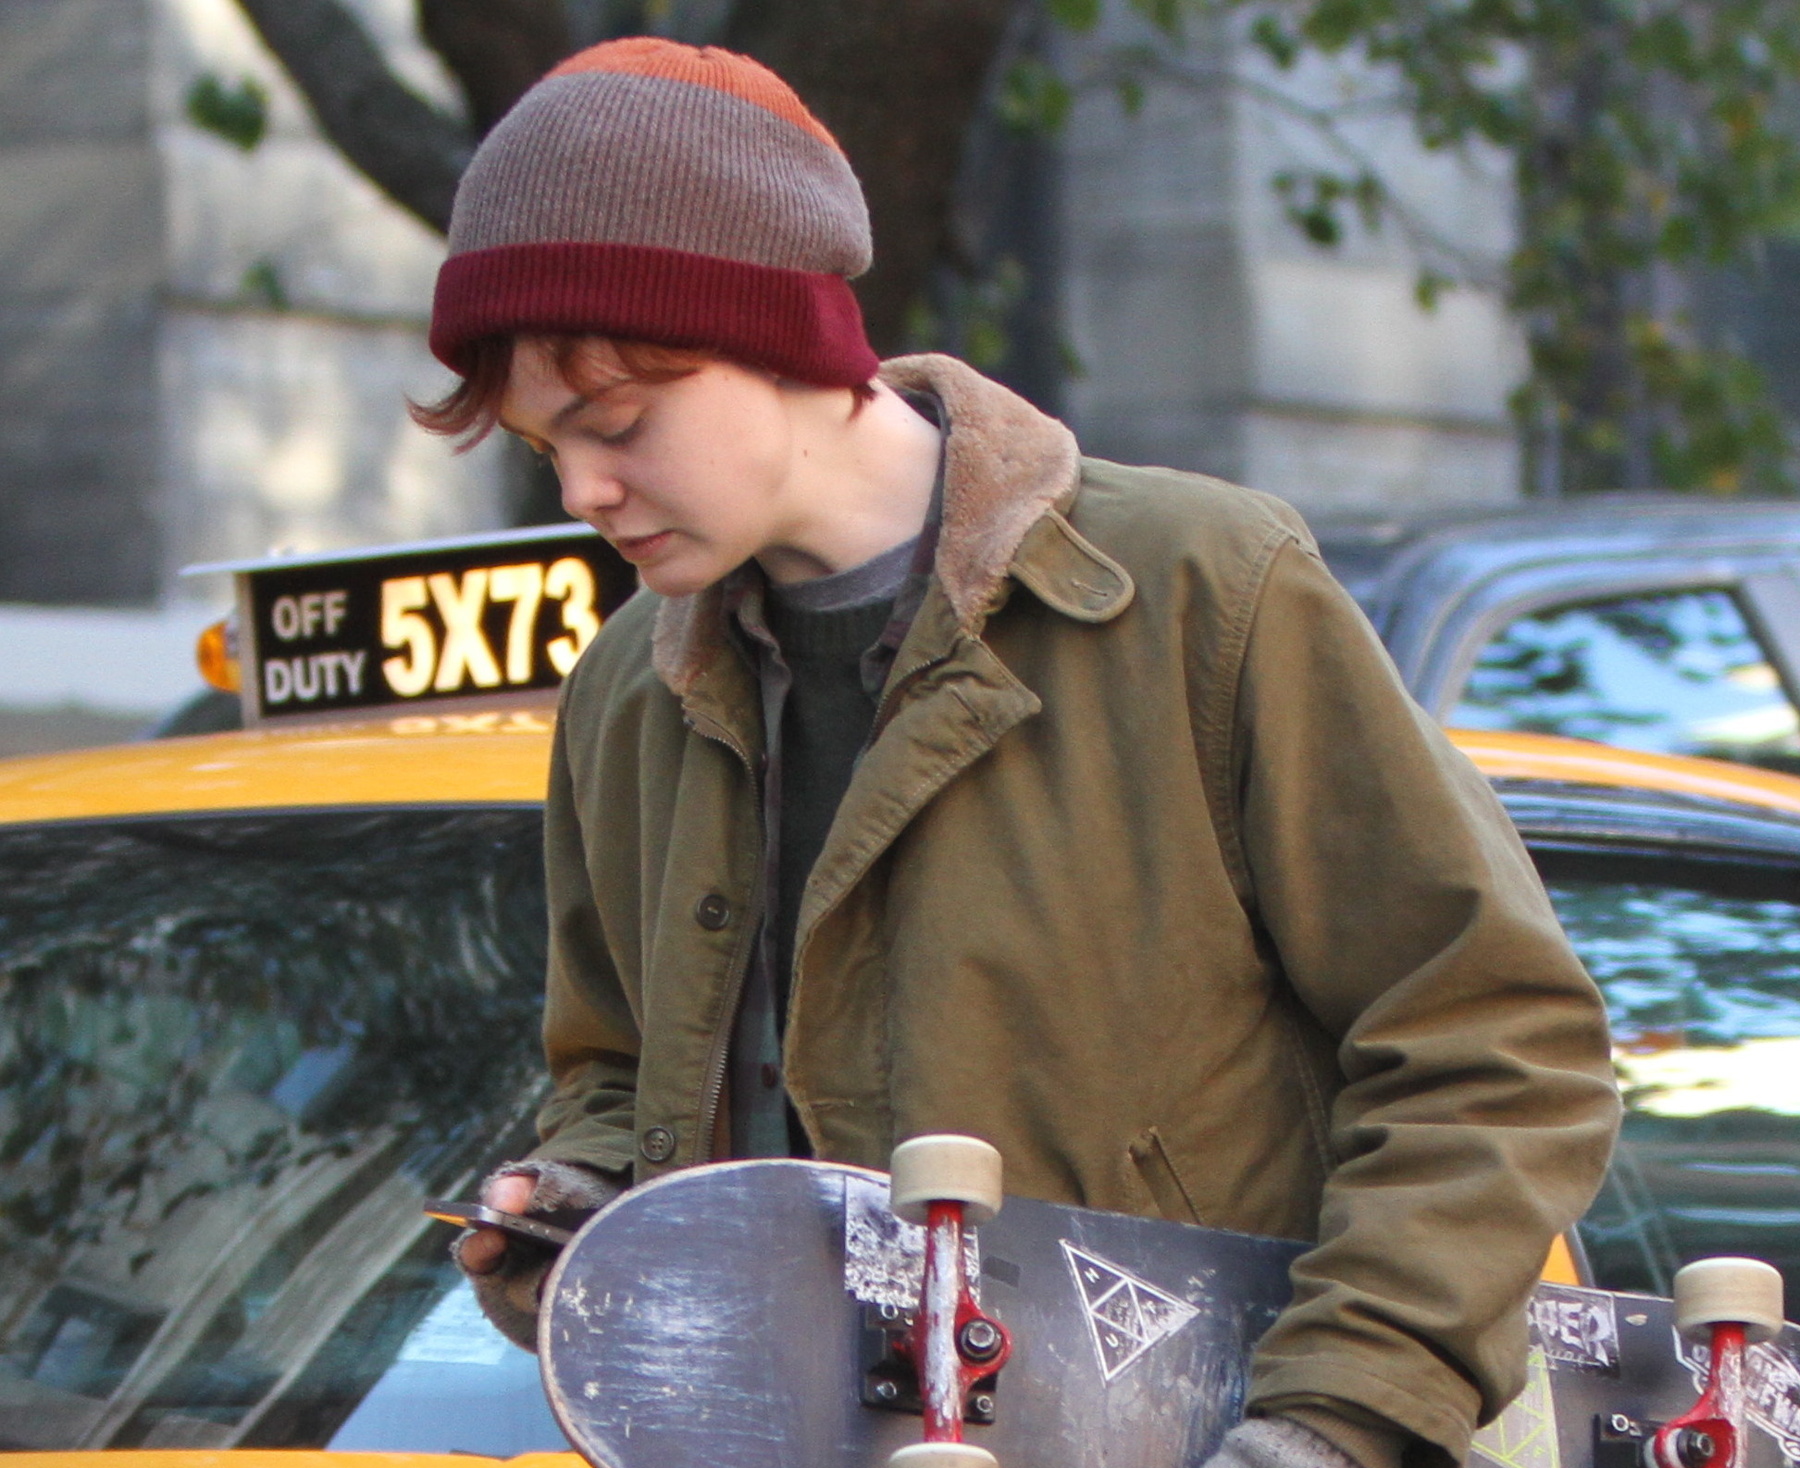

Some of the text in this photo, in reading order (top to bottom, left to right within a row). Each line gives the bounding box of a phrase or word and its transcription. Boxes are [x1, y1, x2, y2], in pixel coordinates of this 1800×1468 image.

[271, 590, 349, 641] OFF
[380, 556, 602, 698] 5X73
[264, 650, 366, 704] DUTY
